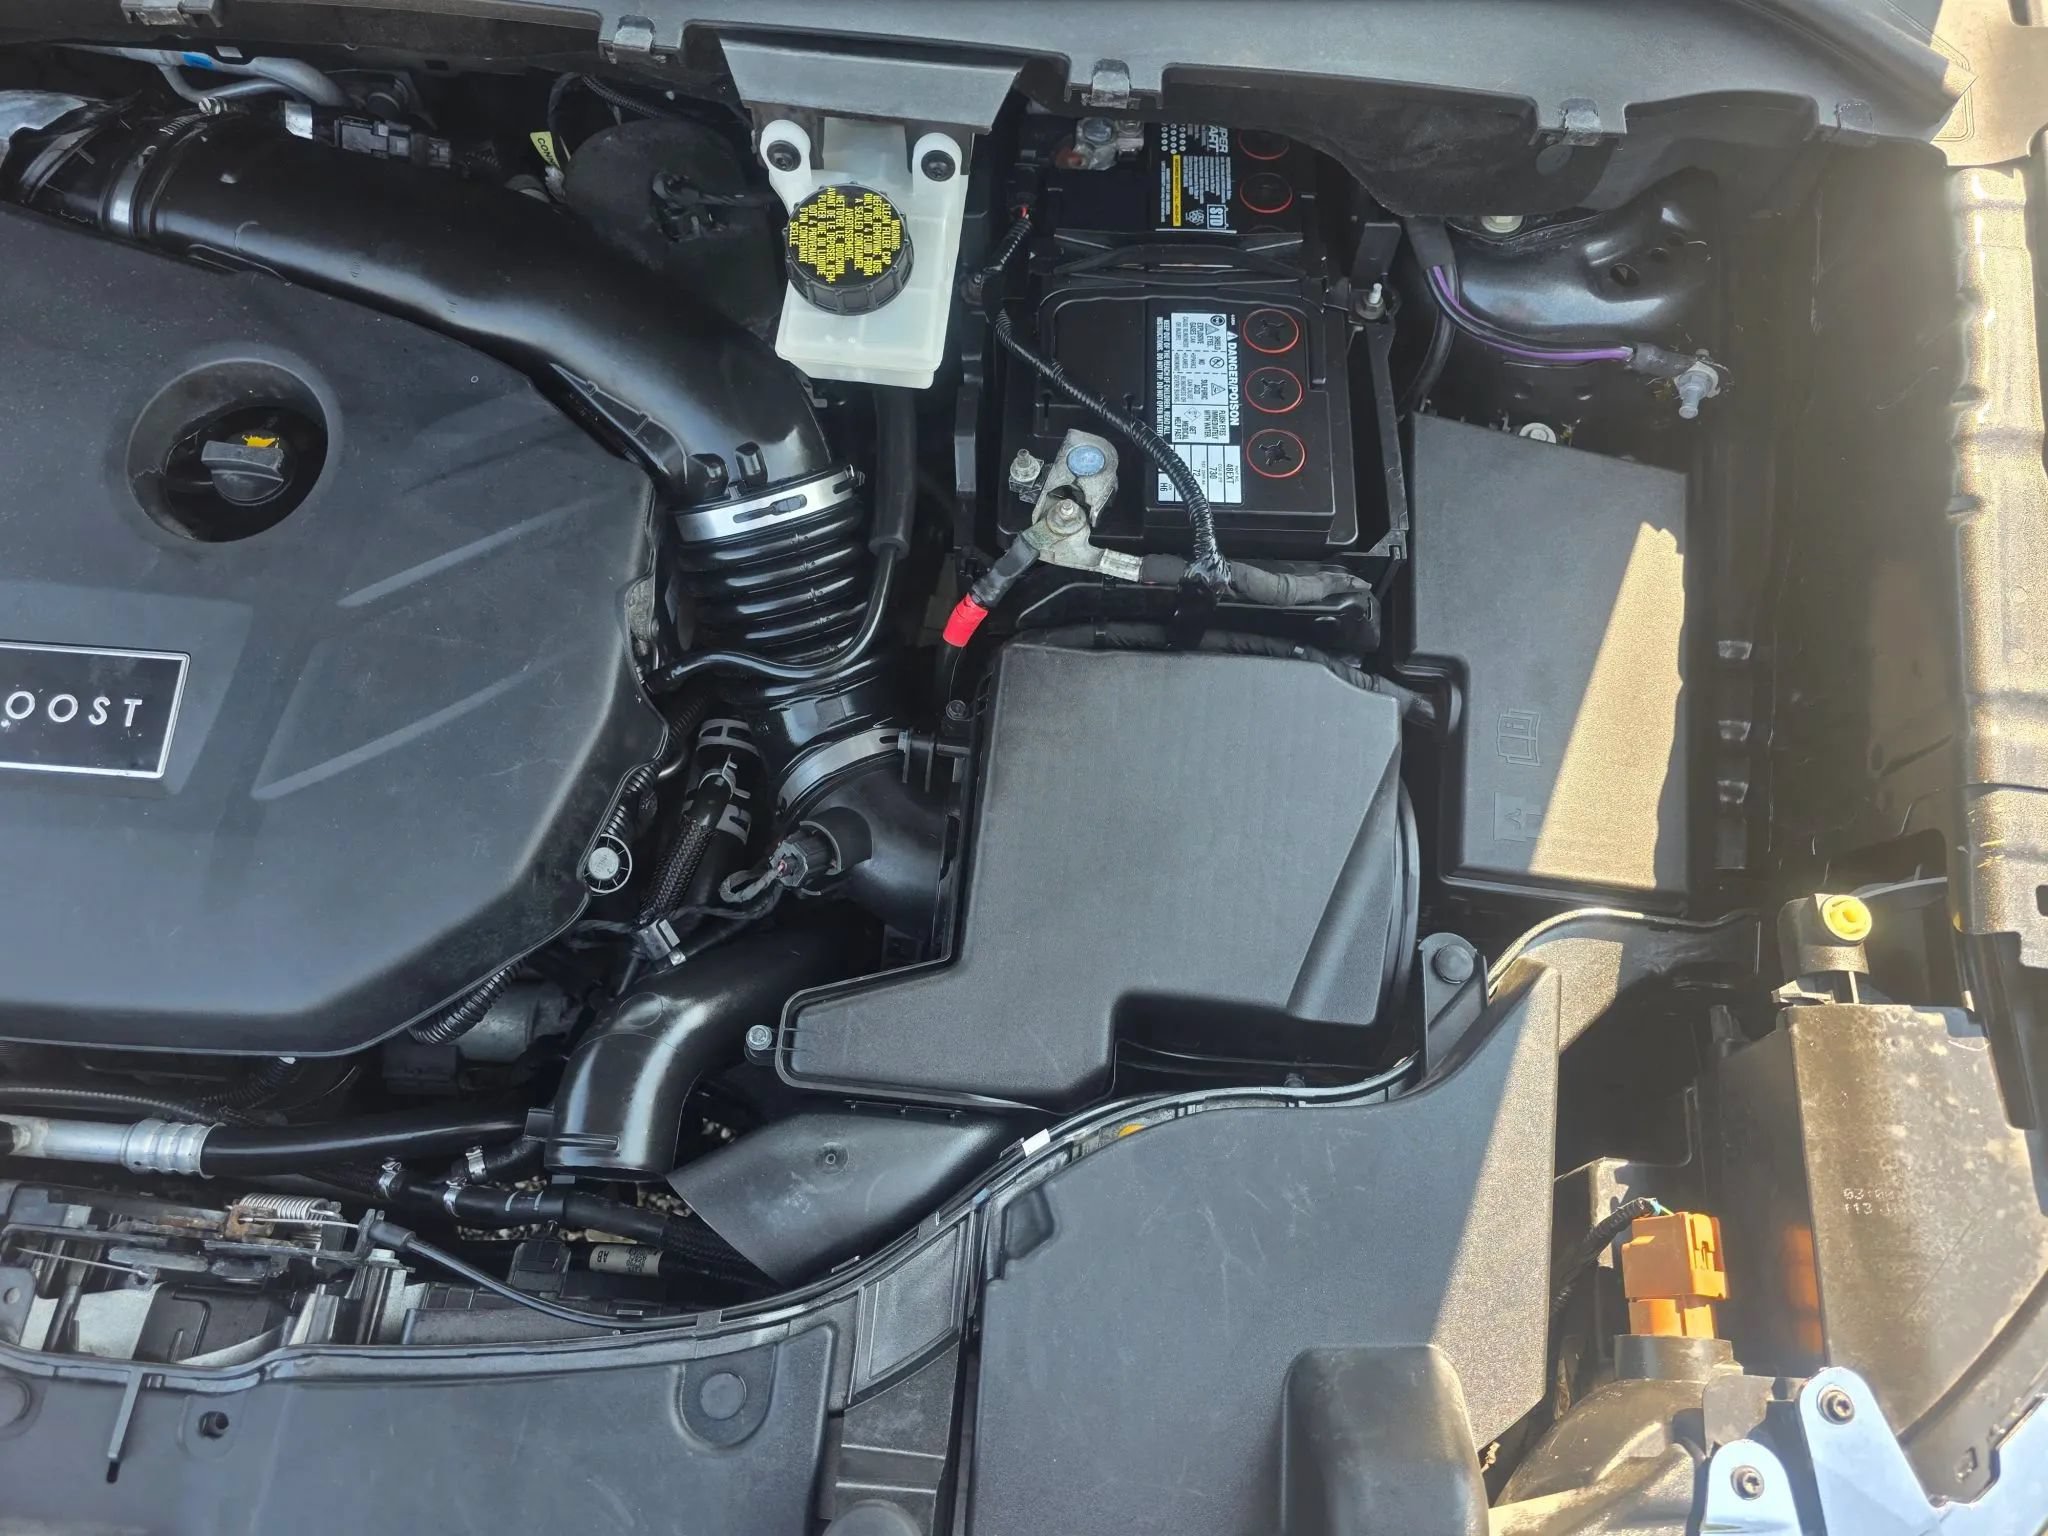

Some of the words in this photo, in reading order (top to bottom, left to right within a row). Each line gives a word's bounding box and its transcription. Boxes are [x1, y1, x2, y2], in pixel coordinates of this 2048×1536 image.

[818, 195, 826, 218] PLOYER
[827, 187, 835, 207] AVANT
[864, 194, 872, 209] ONLY
[800, 208, 808, 222] D'UN
[809, 205, 817, 216] DOT
[827, 210, 835, 218] DE
[836, 196, 844, 227] NETTOYER
[855, 206, 863, 229] SEALED
[873, 196, 882, 219] BEFORE
[883, 204, 891, 223] CLEAN
[1210, 207, 1223, 227] STD
[864, 213, 872, 224] DOT
[799, 226, 808, 262] CONTENANT
[818, 238, 826, 246] DU
[845, 208, 853, 260] AVERTISSEMENT:
[882, 227, 891, 248] FILLER
[892, 220, 900, 251] WARNING:
[808, 228, 817, 264] PROVENANT
[854, 233, 863, 270] CONTAINER.
[864, 236, 872, 253] FLUID
[817, 250, 826, 275] LIQUIDE
[836, 243, 844, 274] BOUCHON
[864, 257, 872, 275] FROM
[873, 260, 882, 273] USE
[882, 252, 891, 264] CAP
[1227, 342, 1239, 426] DANGER/POISON
[1226, 464, 1234, 484] 48EXT
[1159, 482, 1168, 491] H6
[596, 1250, 610, 1263] AB
